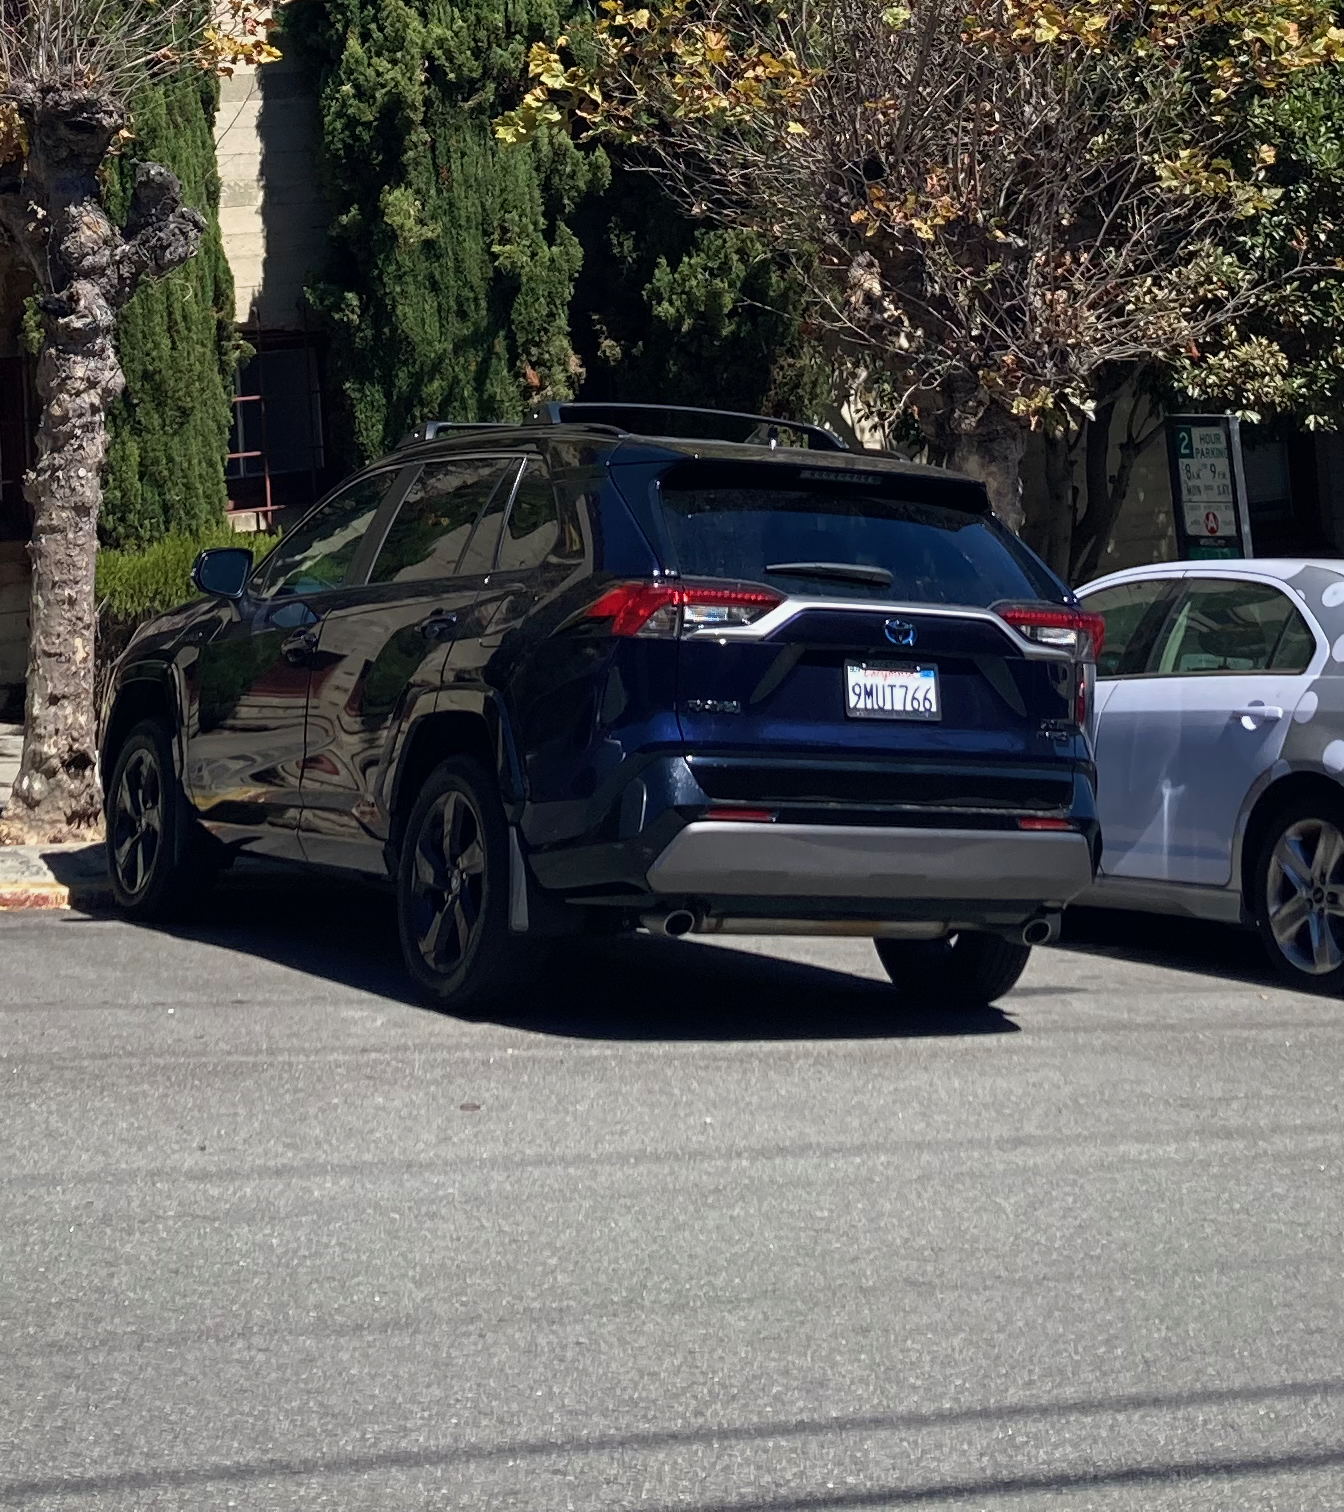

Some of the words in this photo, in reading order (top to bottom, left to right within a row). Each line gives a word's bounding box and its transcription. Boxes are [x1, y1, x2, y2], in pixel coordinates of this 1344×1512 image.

[1179, 431, 1190, 454] 2
[1199, 433, 1221, 445] HOUR
[852, 683, 933, 711] 9MUT766
